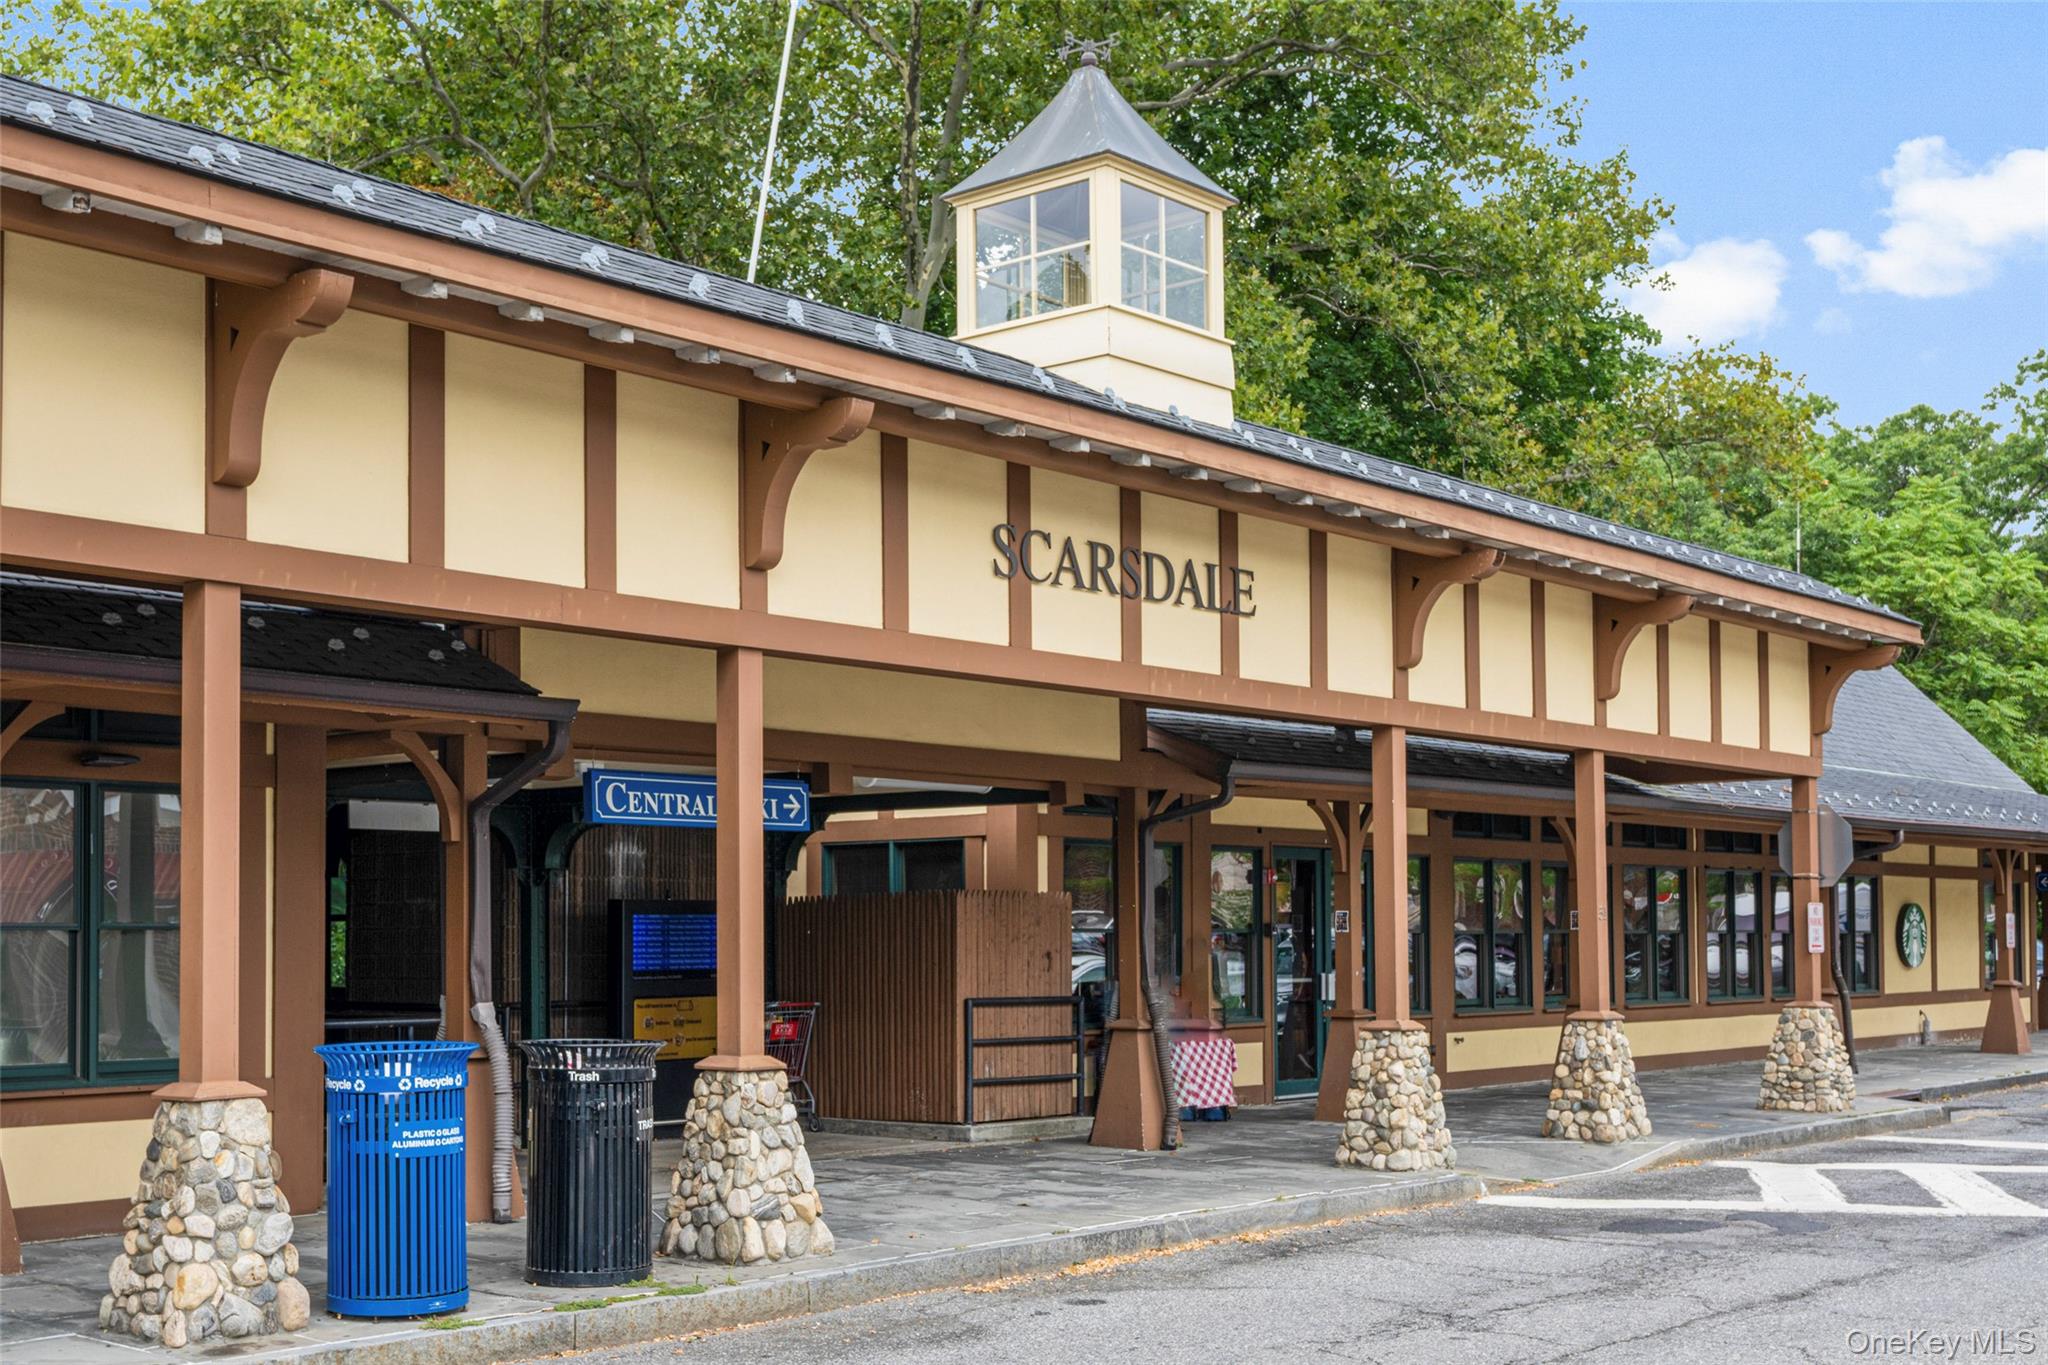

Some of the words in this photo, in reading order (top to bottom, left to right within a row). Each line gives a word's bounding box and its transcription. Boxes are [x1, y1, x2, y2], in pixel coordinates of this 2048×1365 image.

[992, 523, 1257, 617] SCARSDALE
[605, 782, 717, 817] CENTRAL
[414, 1075, 454, 1090] Recycle
[568, 1071, 600, 1082] Trash
[402, 1130, 436, 1139] PLASTIC
[441, 1127, 460, 1136] GLASS
[392, 1139, 435, 1149] ALUMINUM
